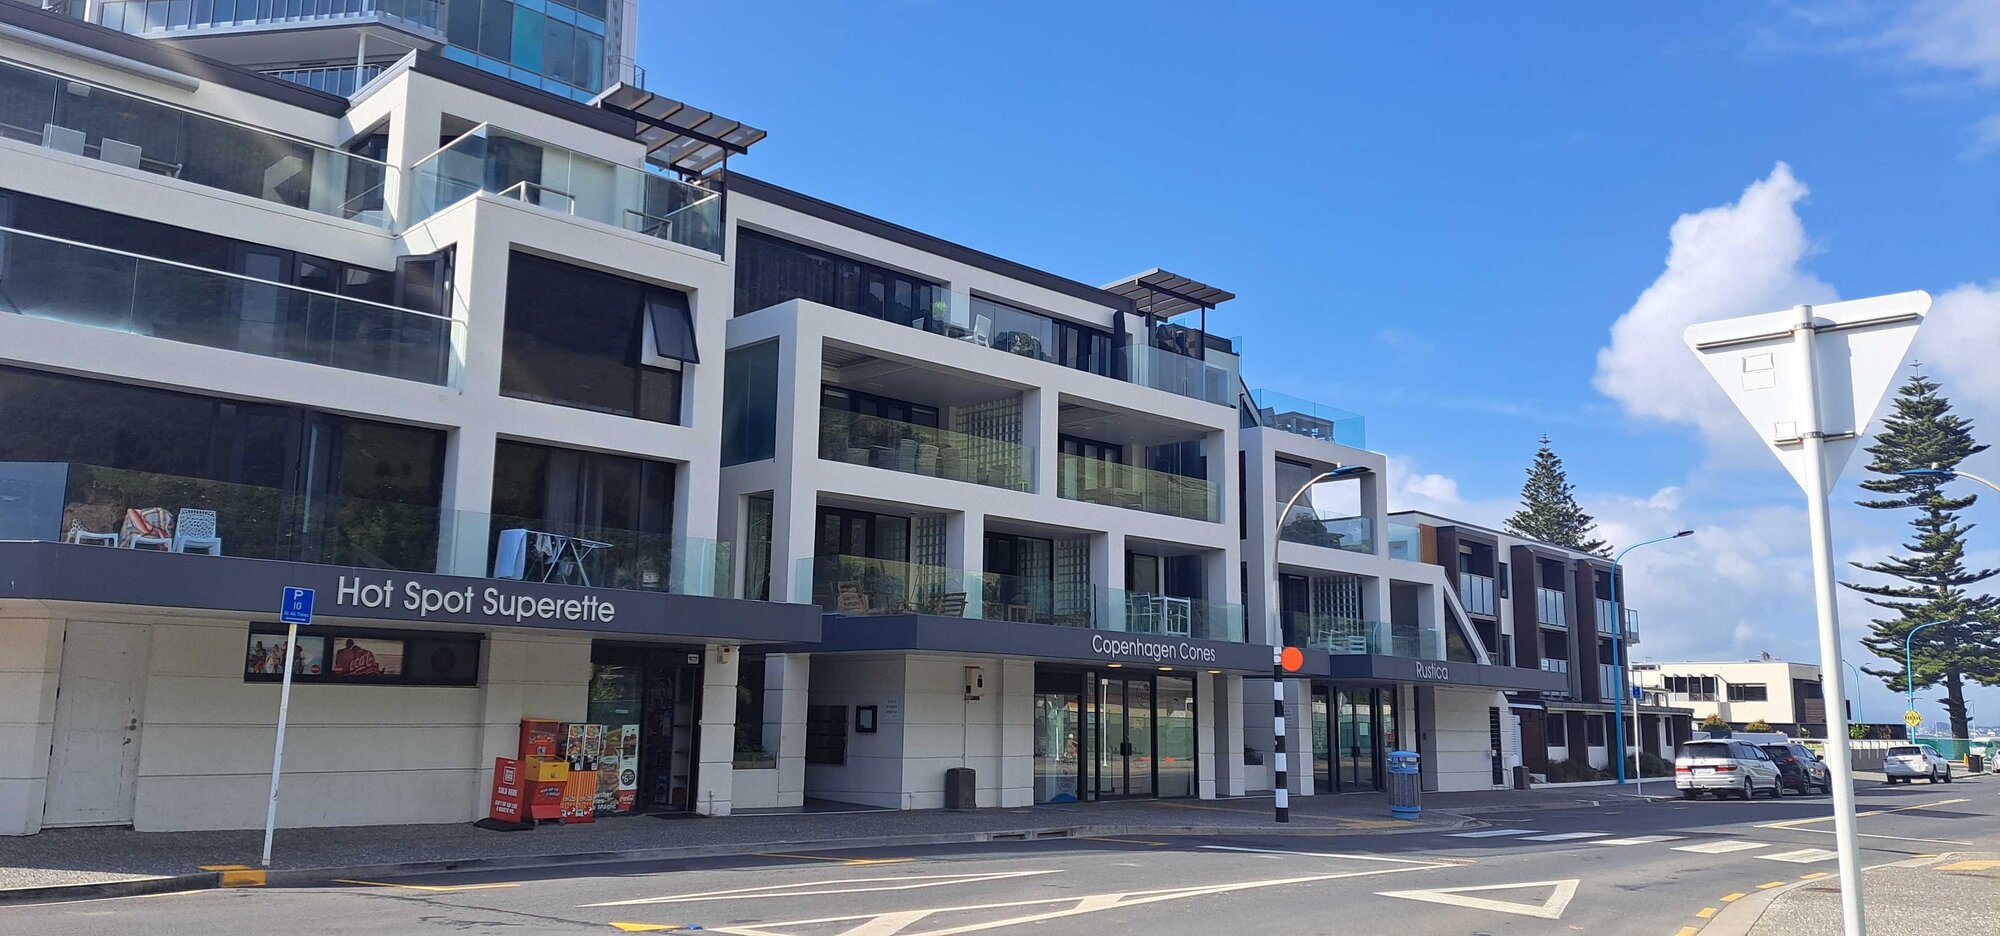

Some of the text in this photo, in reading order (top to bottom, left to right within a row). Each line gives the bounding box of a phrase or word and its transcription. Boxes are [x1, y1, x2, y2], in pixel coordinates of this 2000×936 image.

[294, 590, 303, 600] P
[337, 576, 615, 623] Hot Spot Superette
[293, 602, 302, 610] 10
[1092, 634, 1216, 662] Copenhagen Cones
[1415, 661, 1449, 680] Rustica
